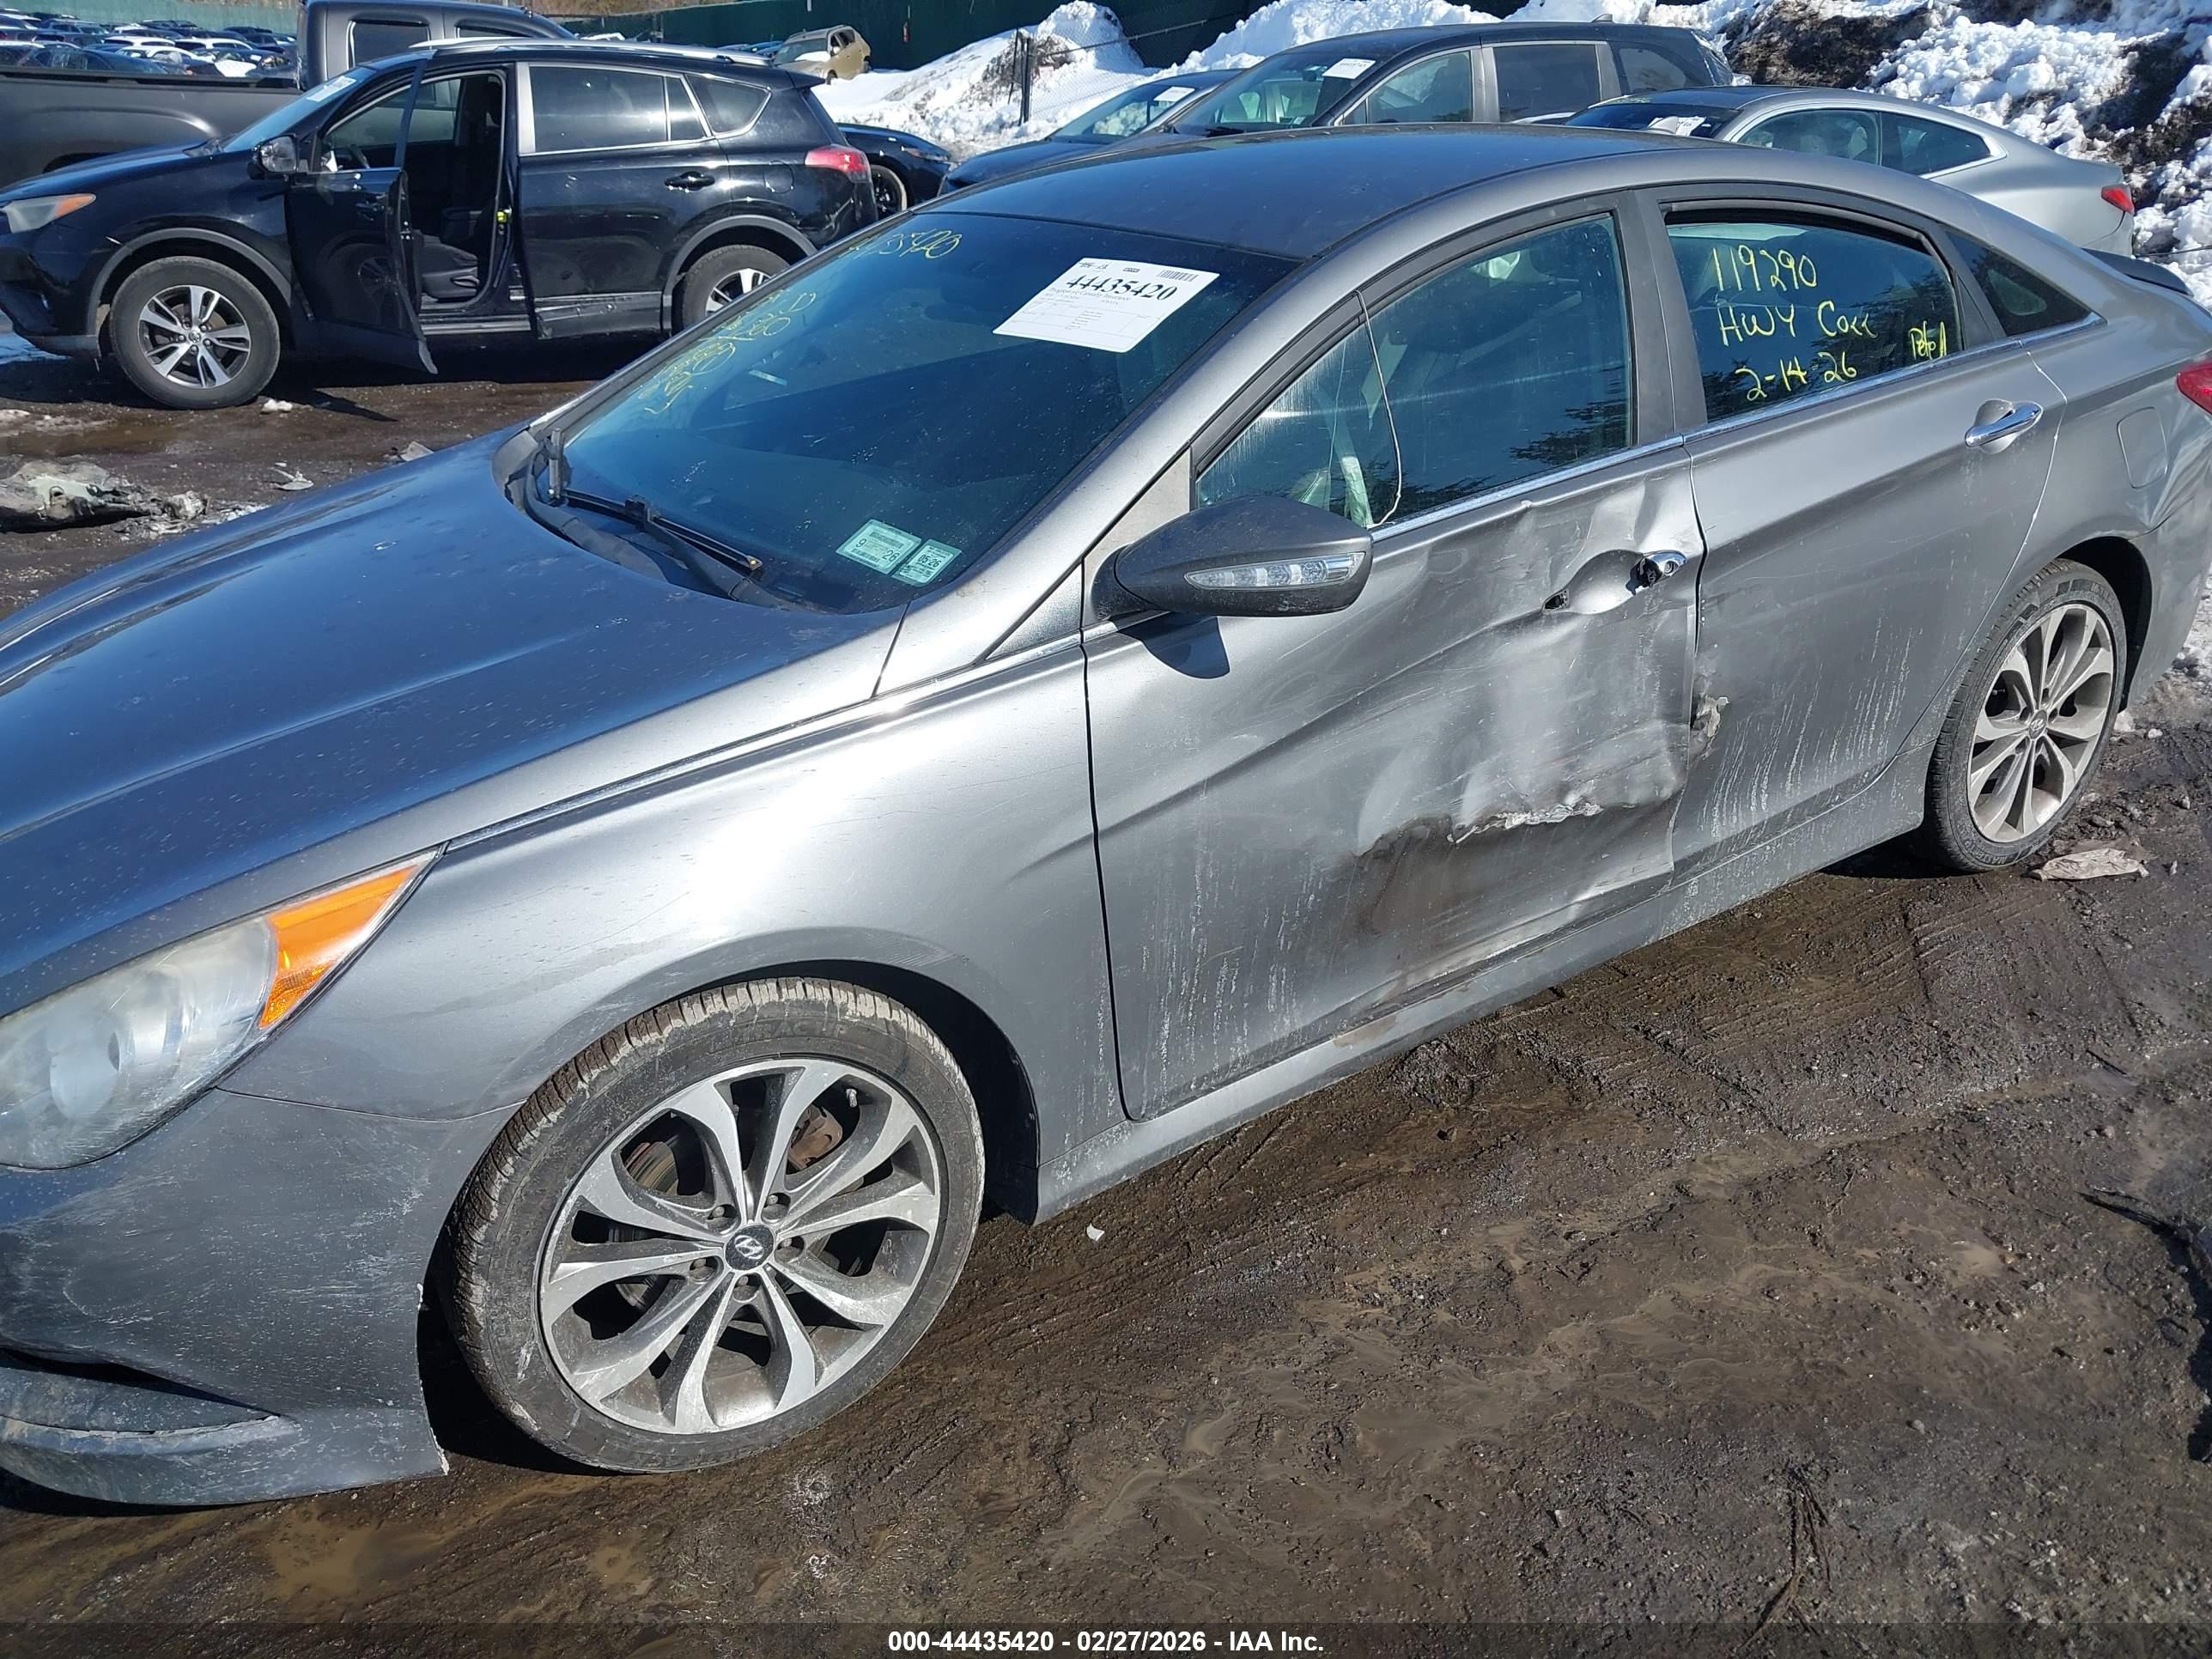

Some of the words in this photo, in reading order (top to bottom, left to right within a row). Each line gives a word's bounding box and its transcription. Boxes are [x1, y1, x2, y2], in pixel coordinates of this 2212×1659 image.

[1066, 274, 1178, 301] 44435420
[1712, 244, 1818, 292] 119290
[1717, 303, 1796, 347] HWY
[1735, 350, 1857, 401] 2-14-26
